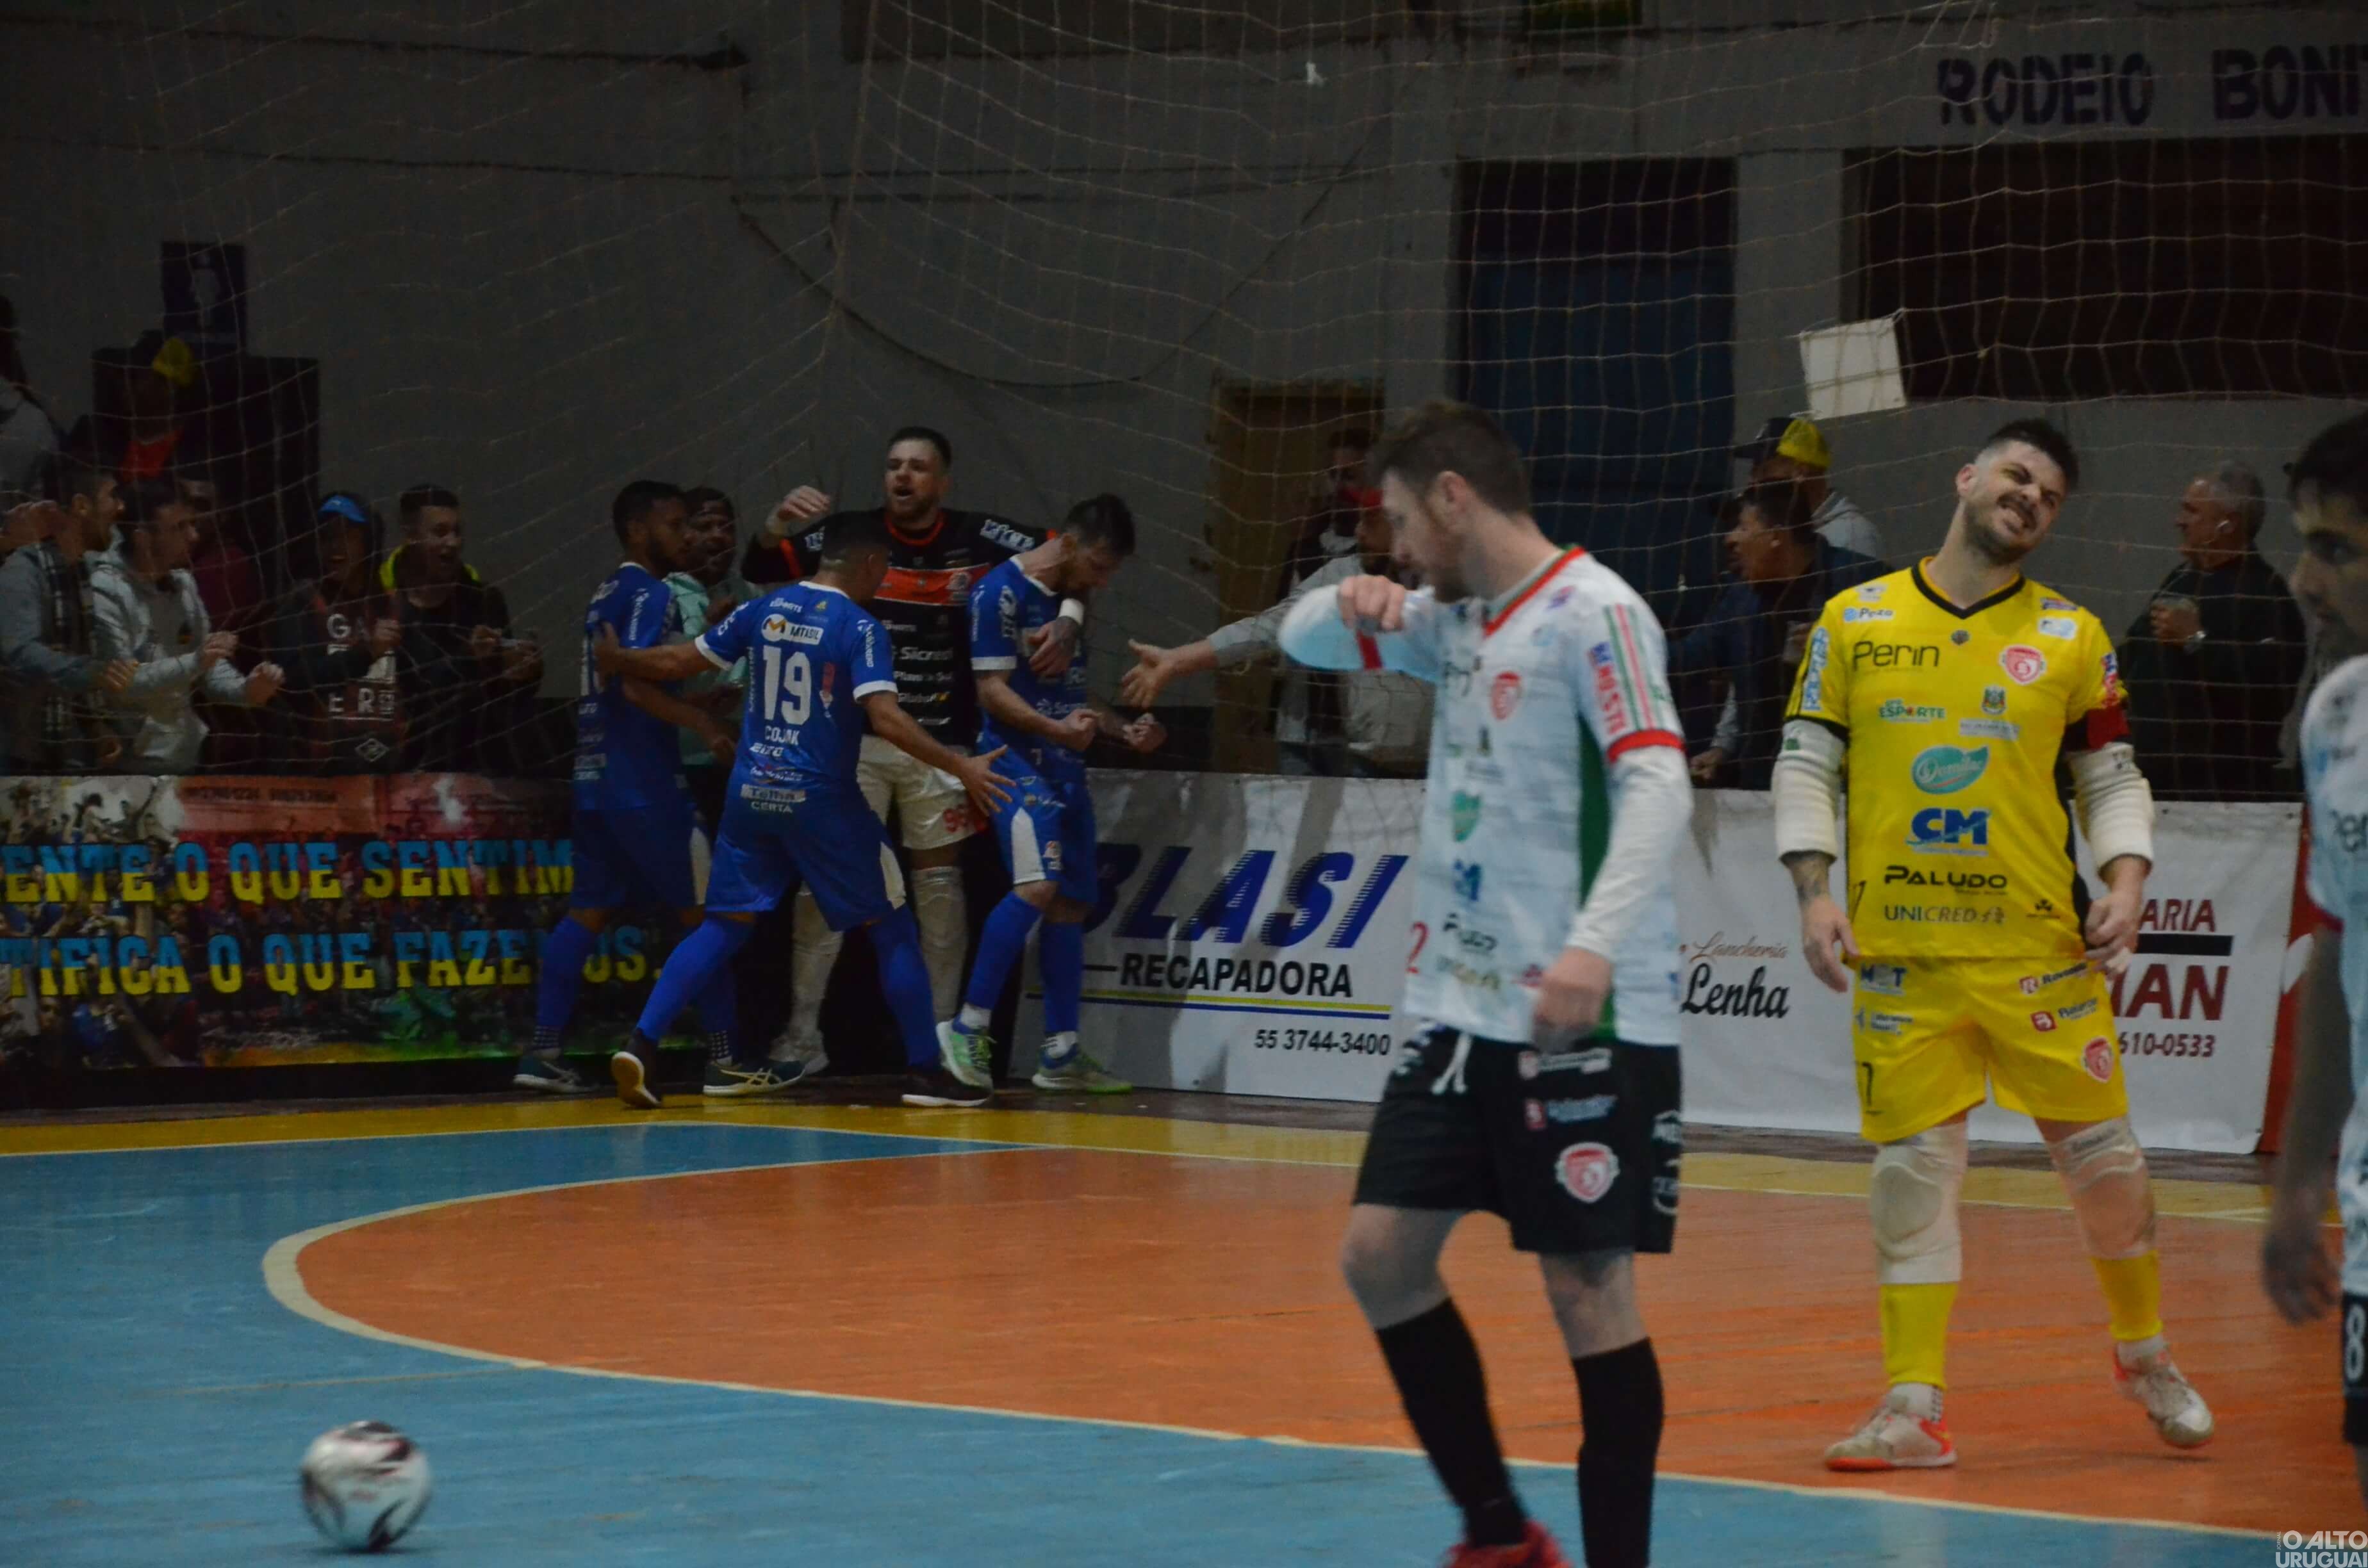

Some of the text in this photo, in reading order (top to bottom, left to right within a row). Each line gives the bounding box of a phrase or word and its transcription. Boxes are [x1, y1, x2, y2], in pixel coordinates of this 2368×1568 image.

[1937, 52, 2154, 126] RODEIO
[763, 644, 812, 725] 19
[1912, 808, 1987, 845] CM
[174, 842, 210, 902] O
[229, 842, 343, 904] QUE
[207, 933, 243, 993] O
[262, 933, 377, 996] QUE
[1121, 953, 1352, 997] RECAPADORA
[1680, 962, 1790, 1018] Lenha
[1254, 1029, 1391, 1055] 55 3744-3400
